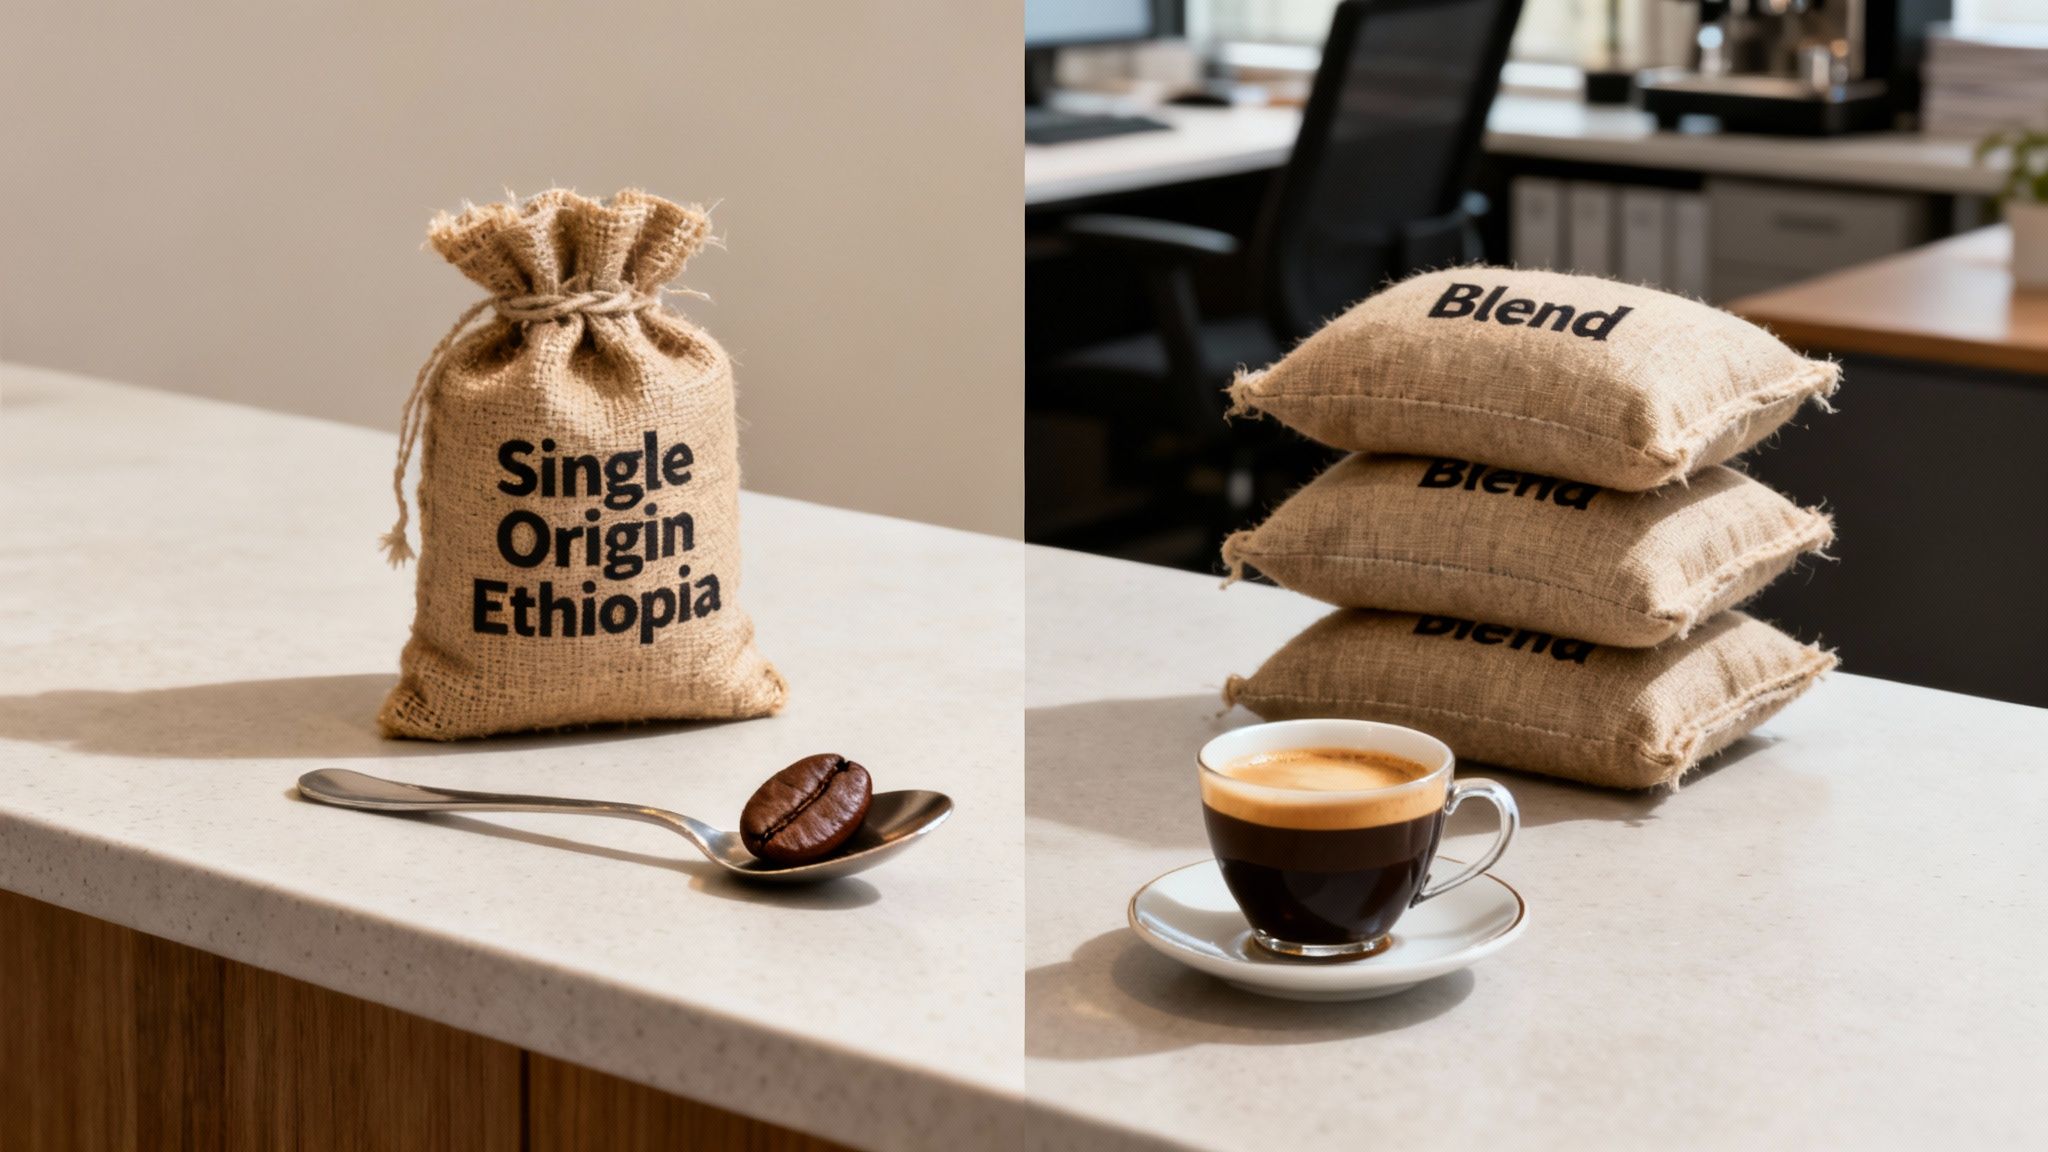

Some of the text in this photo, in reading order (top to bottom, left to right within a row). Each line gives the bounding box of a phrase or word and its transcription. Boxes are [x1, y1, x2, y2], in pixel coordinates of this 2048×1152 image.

[1428, 283, 1634, 340] Blend
[497, 431, 694, 510] Single
[1418, 457, 1600, 510] Blend
[497, 503, 695, 580] Origin
[473, 564, 721, 644] Ethiopia
